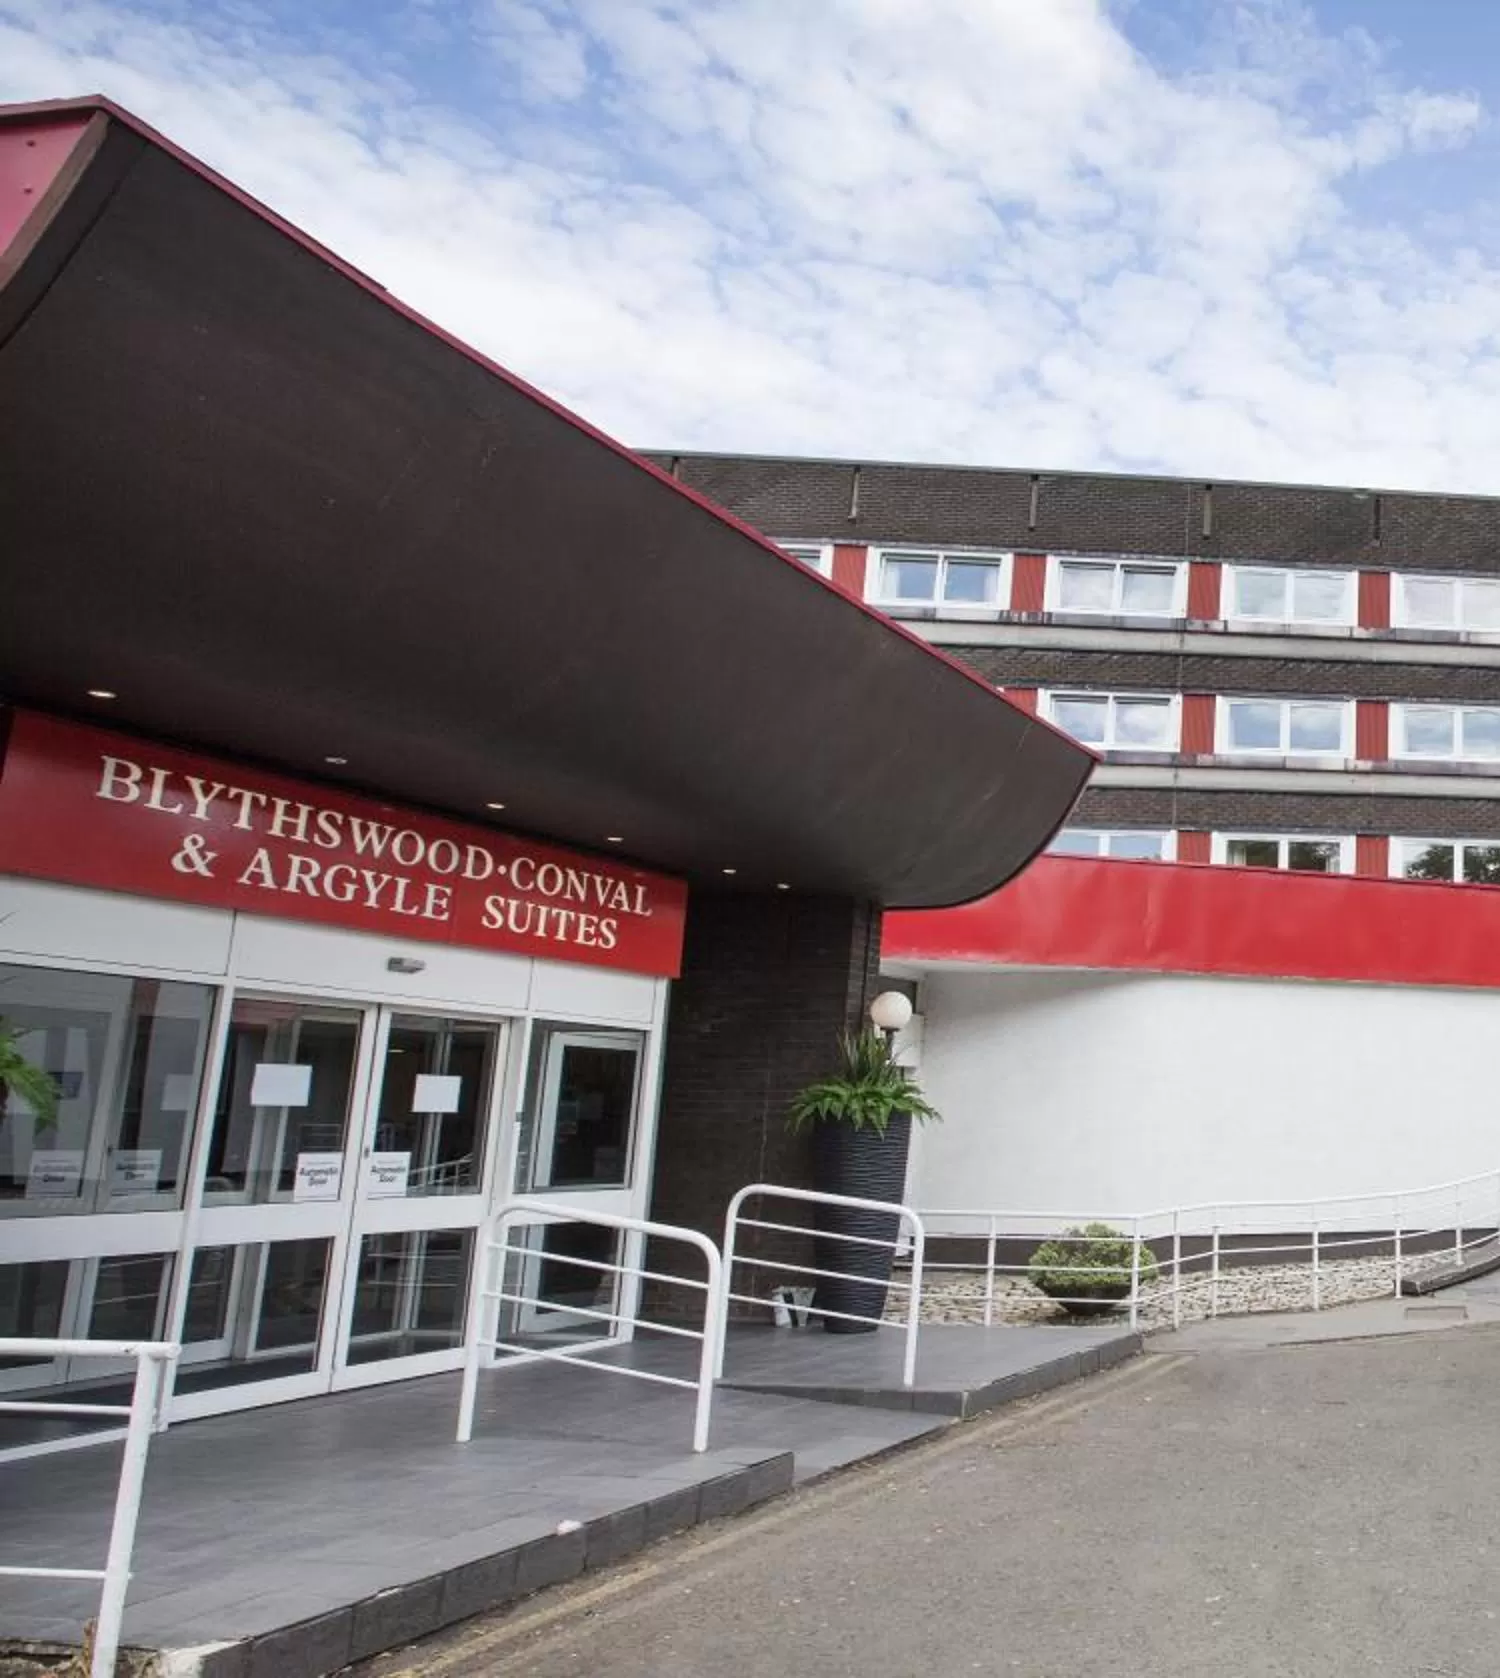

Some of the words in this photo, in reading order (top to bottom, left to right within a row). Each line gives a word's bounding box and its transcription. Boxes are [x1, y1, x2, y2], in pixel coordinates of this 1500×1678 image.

[171, 833, 214, 877] &
[238, 848, 452, 921] ARGYLE
[481, 896, 617, 949] SUITES
